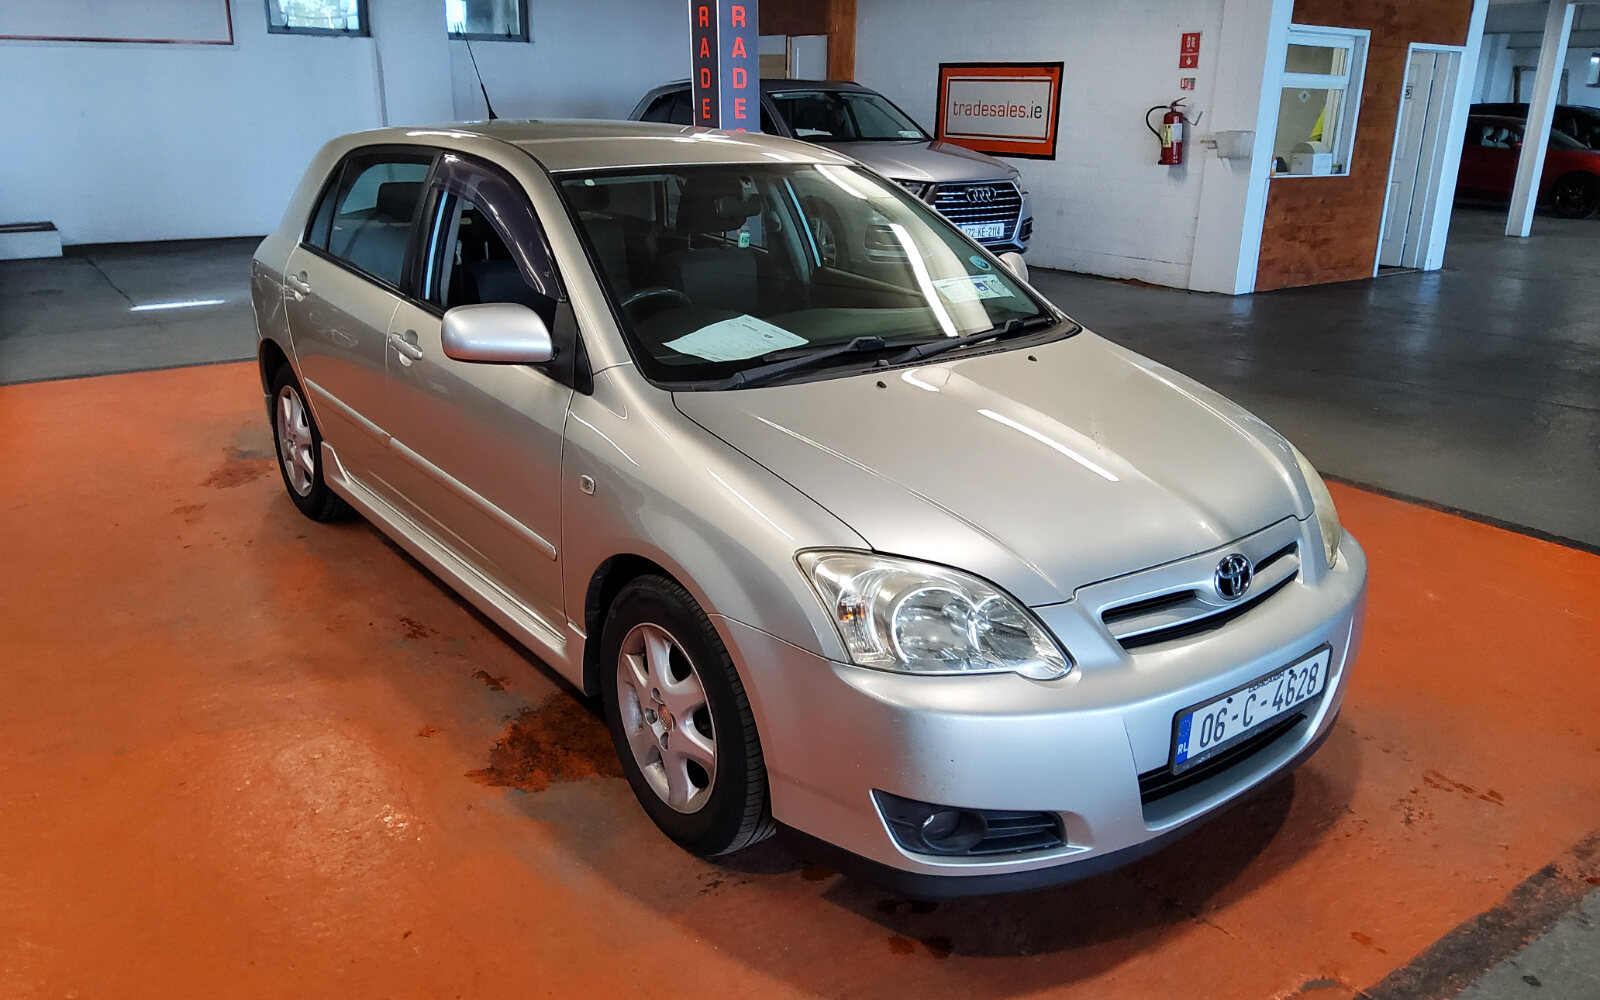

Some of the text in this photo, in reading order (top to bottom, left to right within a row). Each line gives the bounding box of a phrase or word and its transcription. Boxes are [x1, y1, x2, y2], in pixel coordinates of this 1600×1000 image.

[731, 5, 747, 132] RADE
[953, 99, 1042, 119] tradesales.ie
[1199, 662, 1319, 748] 06-C-4628
